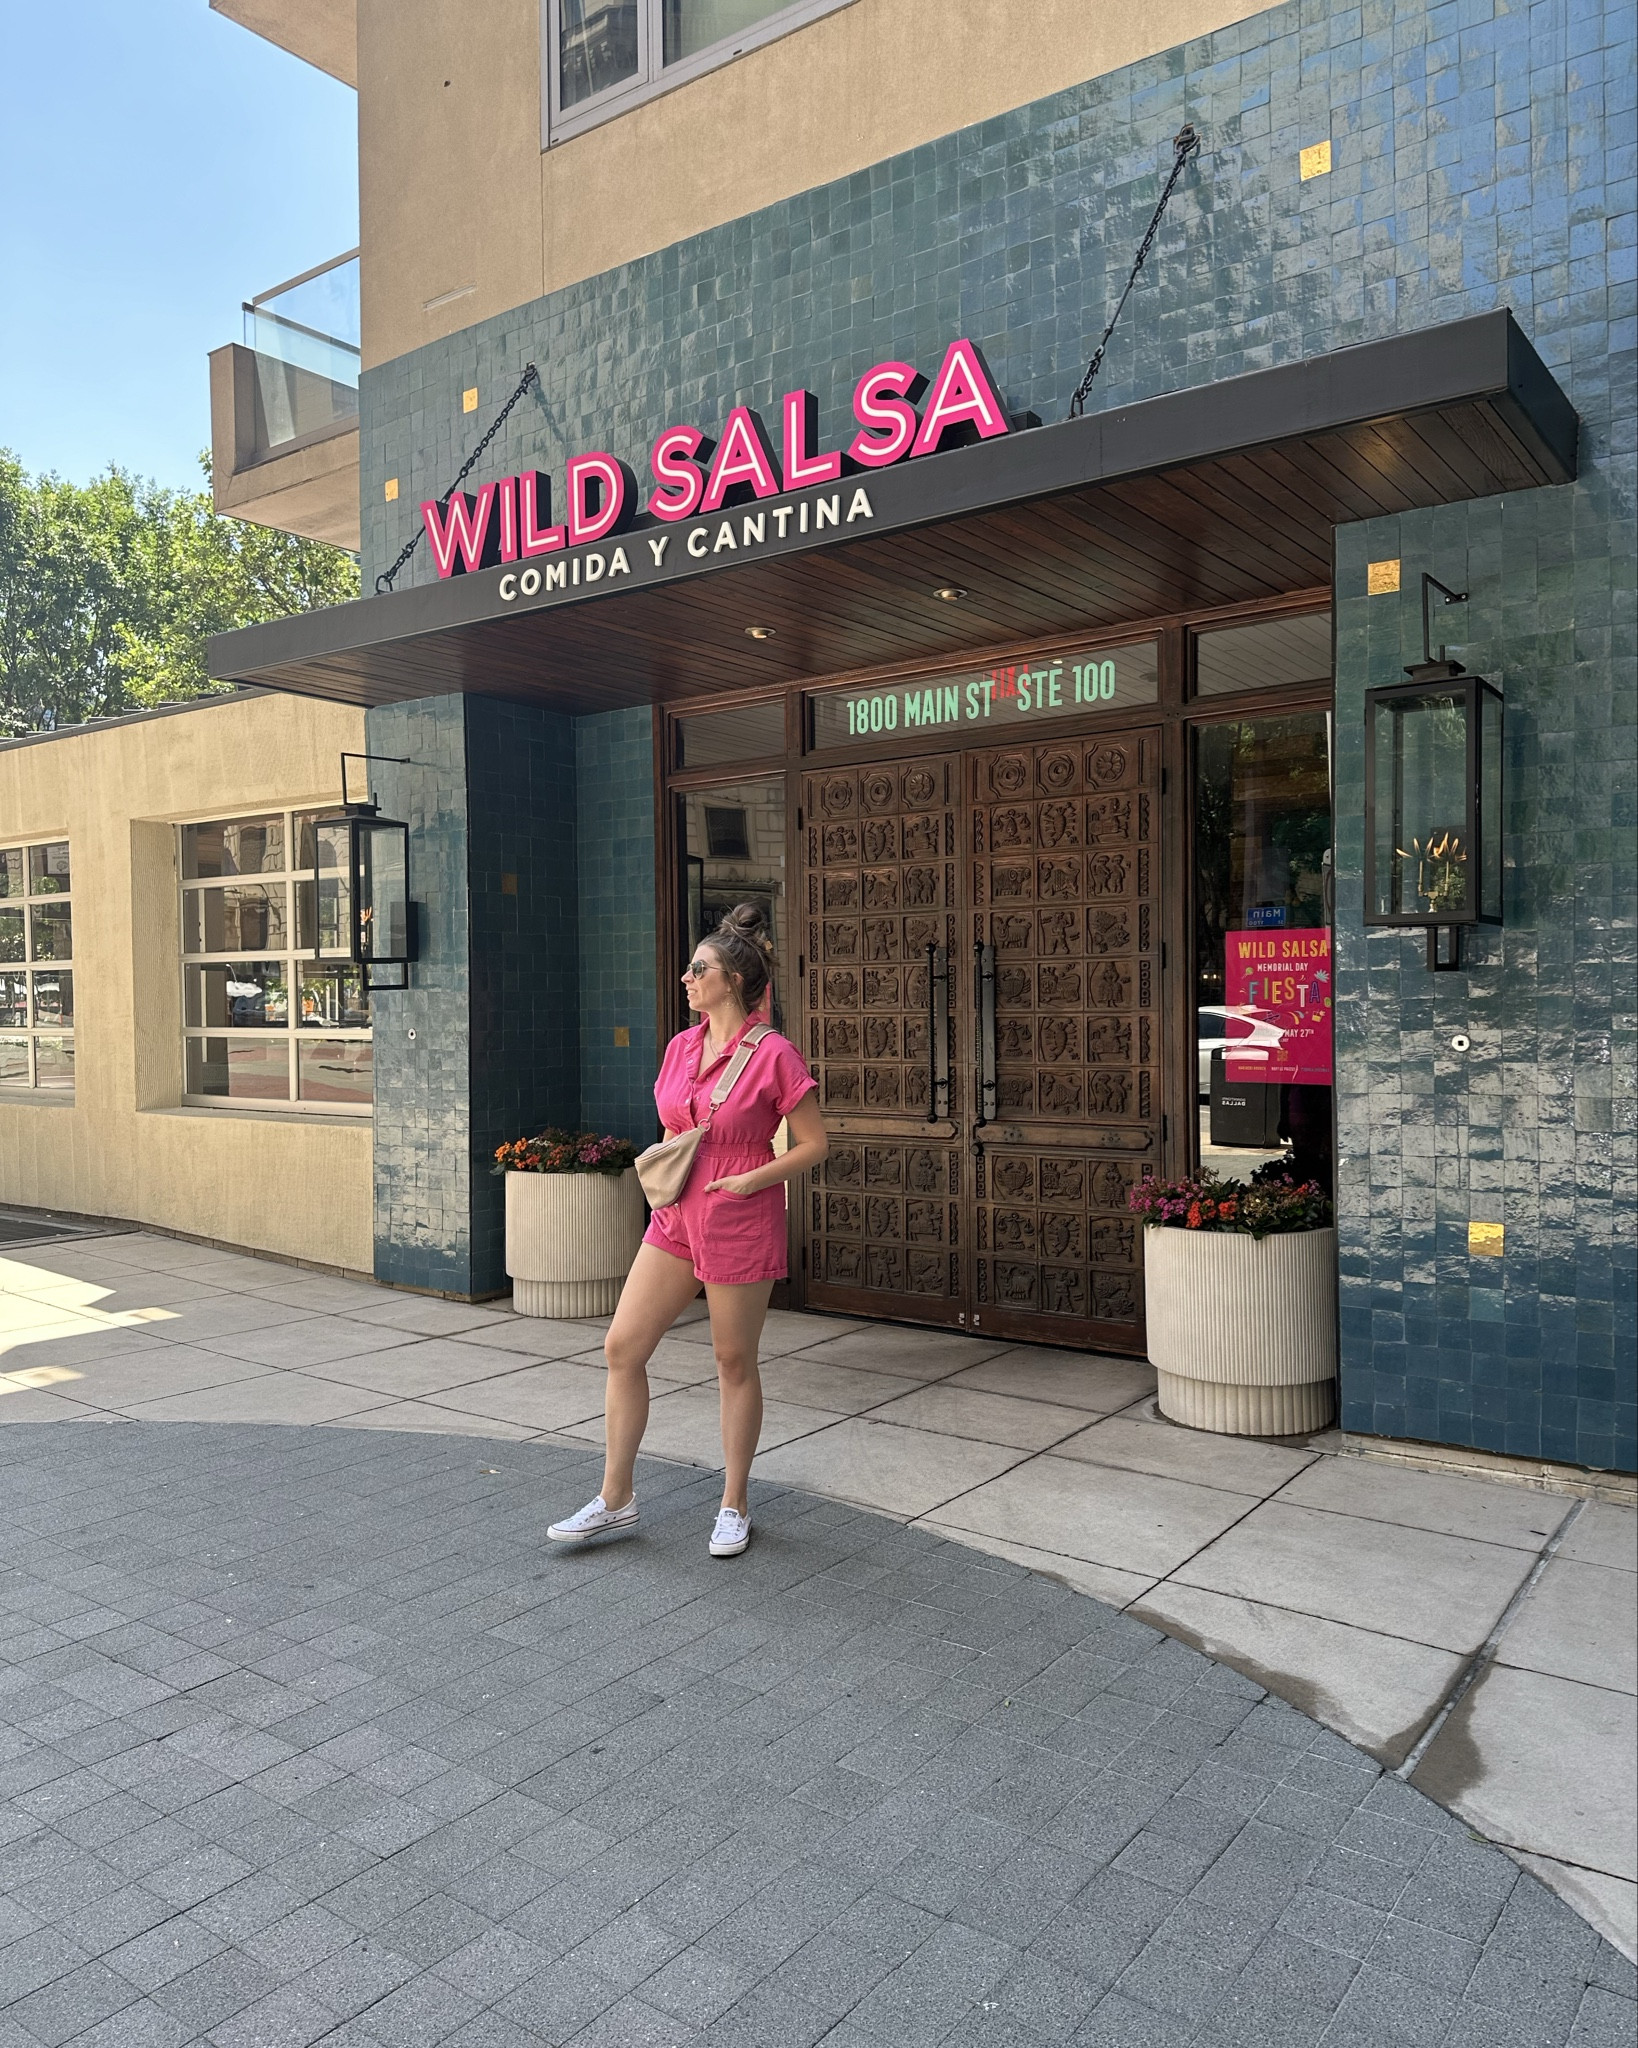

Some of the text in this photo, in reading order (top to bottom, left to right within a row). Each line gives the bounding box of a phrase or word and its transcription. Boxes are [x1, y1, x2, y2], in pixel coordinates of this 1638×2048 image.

[421, 338, 1007, 578] WILD SALSA
[498, 487, 874, 602] COMIDA Y CANTINA
[846, 660, 1116, 735] 1800 MAIN ST STE 100
[1238, 939, 1329, 959] WILD SALSA
[1257, 962, 1309, 972] MEMORIAL DAY
[1249, 976, 1320, 1008] FIESTA
[1284, 1028, 1299, 1038] MAY
